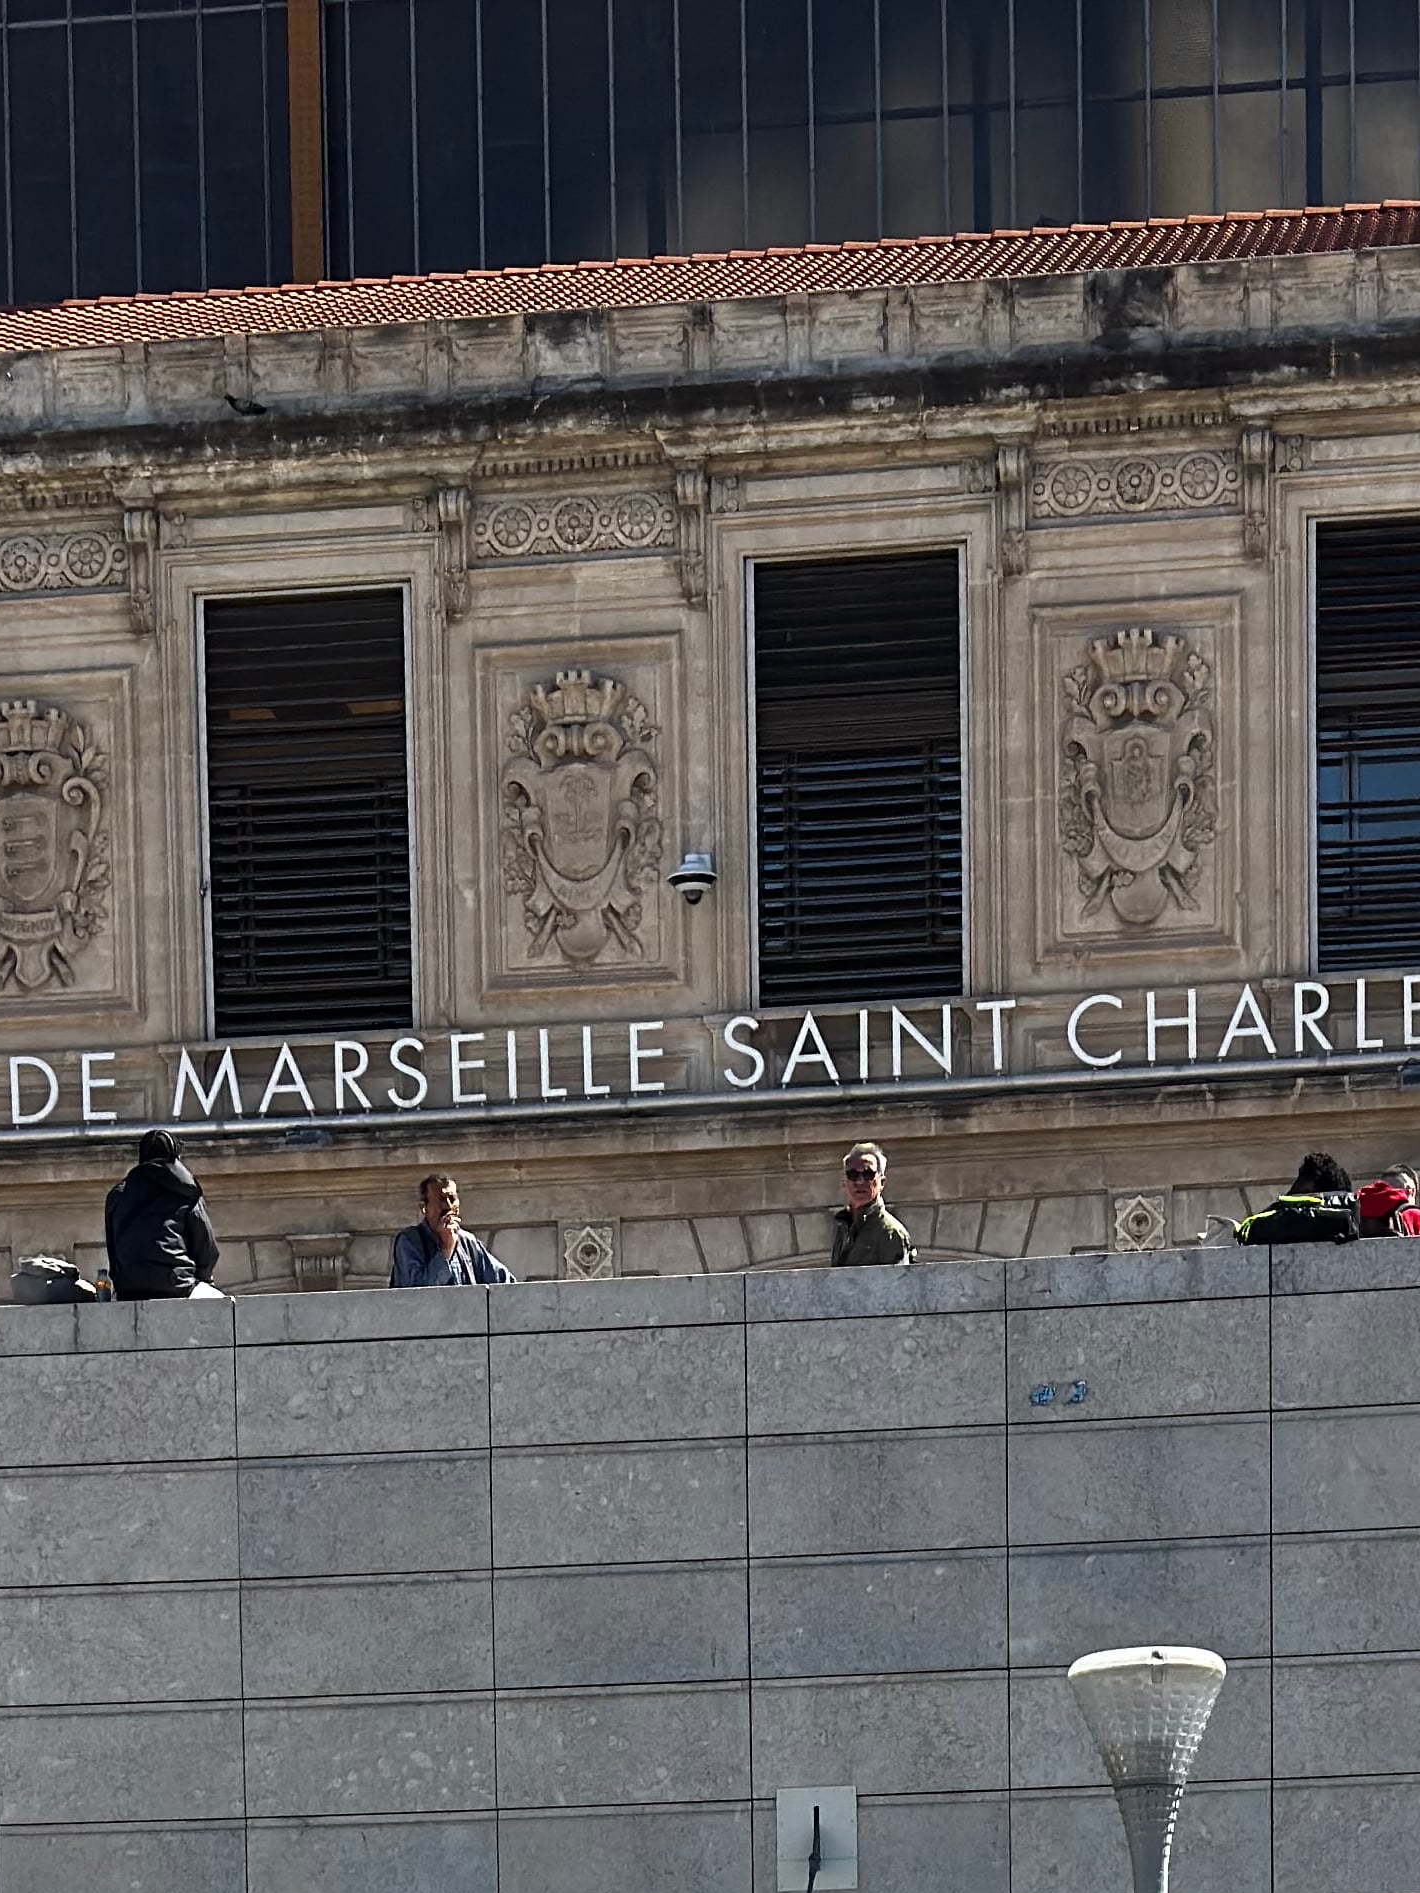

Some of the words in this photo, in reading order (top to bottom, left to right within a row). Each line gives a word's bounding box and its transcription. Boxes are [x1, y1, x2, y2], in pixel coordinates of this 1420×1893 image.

[9, 1051, 118, 1124] DE
[172, 1020, 666, 1118] MARSEILLE
[723, 998, 1016, 1087] SAINT
